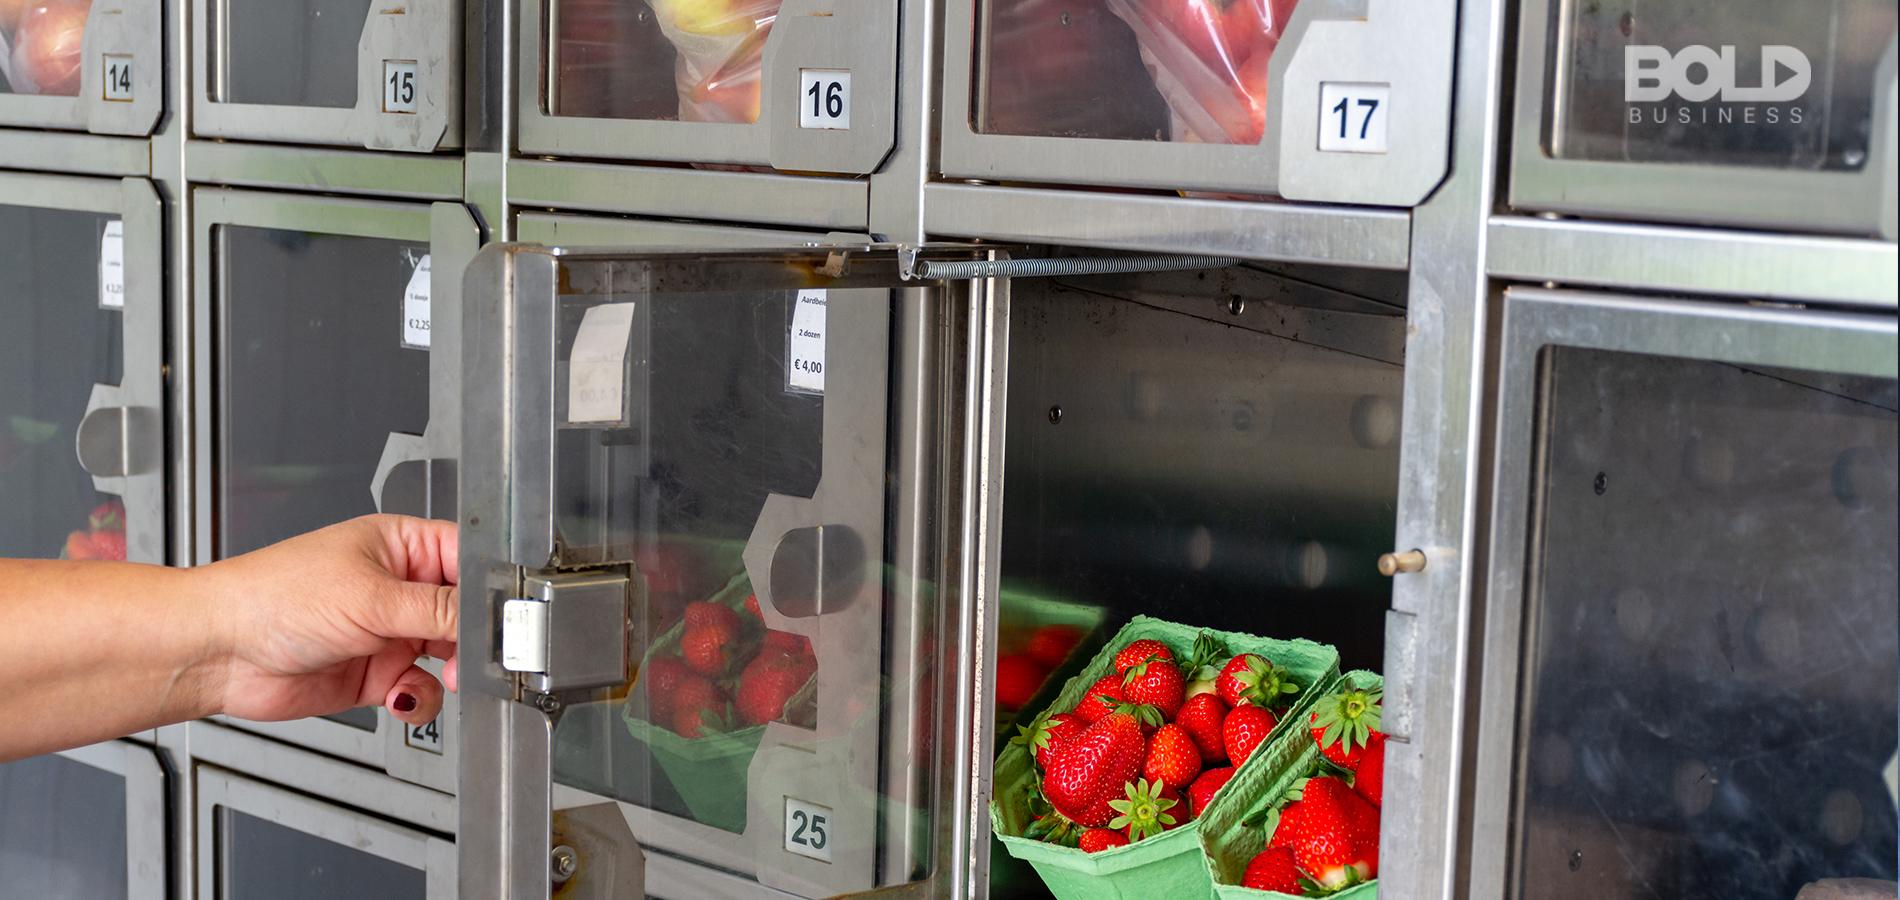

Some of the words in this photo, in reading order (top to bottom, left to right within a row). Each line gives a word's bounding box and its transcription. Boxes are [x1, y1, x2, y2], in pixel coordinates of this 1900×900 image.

[109, 64, 130, 92] 14
[390, 71, 413, 103] 15
[808, 81, 842, 117] 16
[1333, 97, 1378, 138] 17
[798, 328, 803, 337] 2
[804, 329, 821, 339] dozen
[794, 359, 801, 370] €
[802, 360, 822, 374] 4,00
[791, 810, 826, 849] 25
